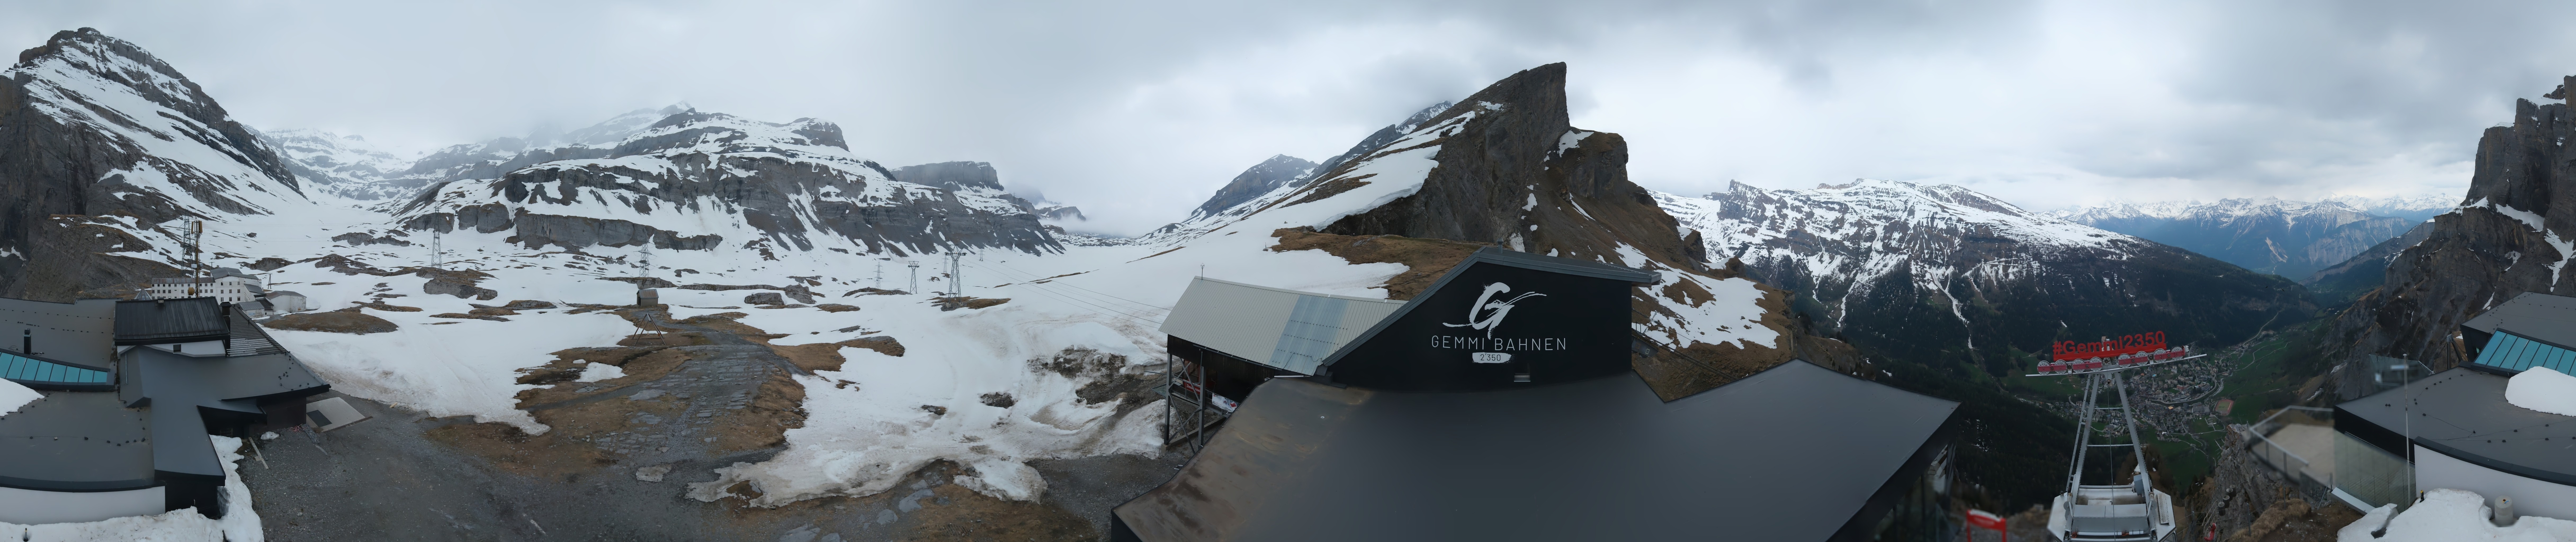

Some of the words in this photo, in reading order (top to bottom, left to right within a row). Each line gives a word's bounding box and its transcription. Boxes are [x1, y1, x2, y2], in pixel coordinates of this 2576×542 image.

[1432, 335, 1484, 350] GEMMI
[1495, 338, 1565, 351] BAHNEN
[2052, 331, 2165, 355] #Gemmi2350
